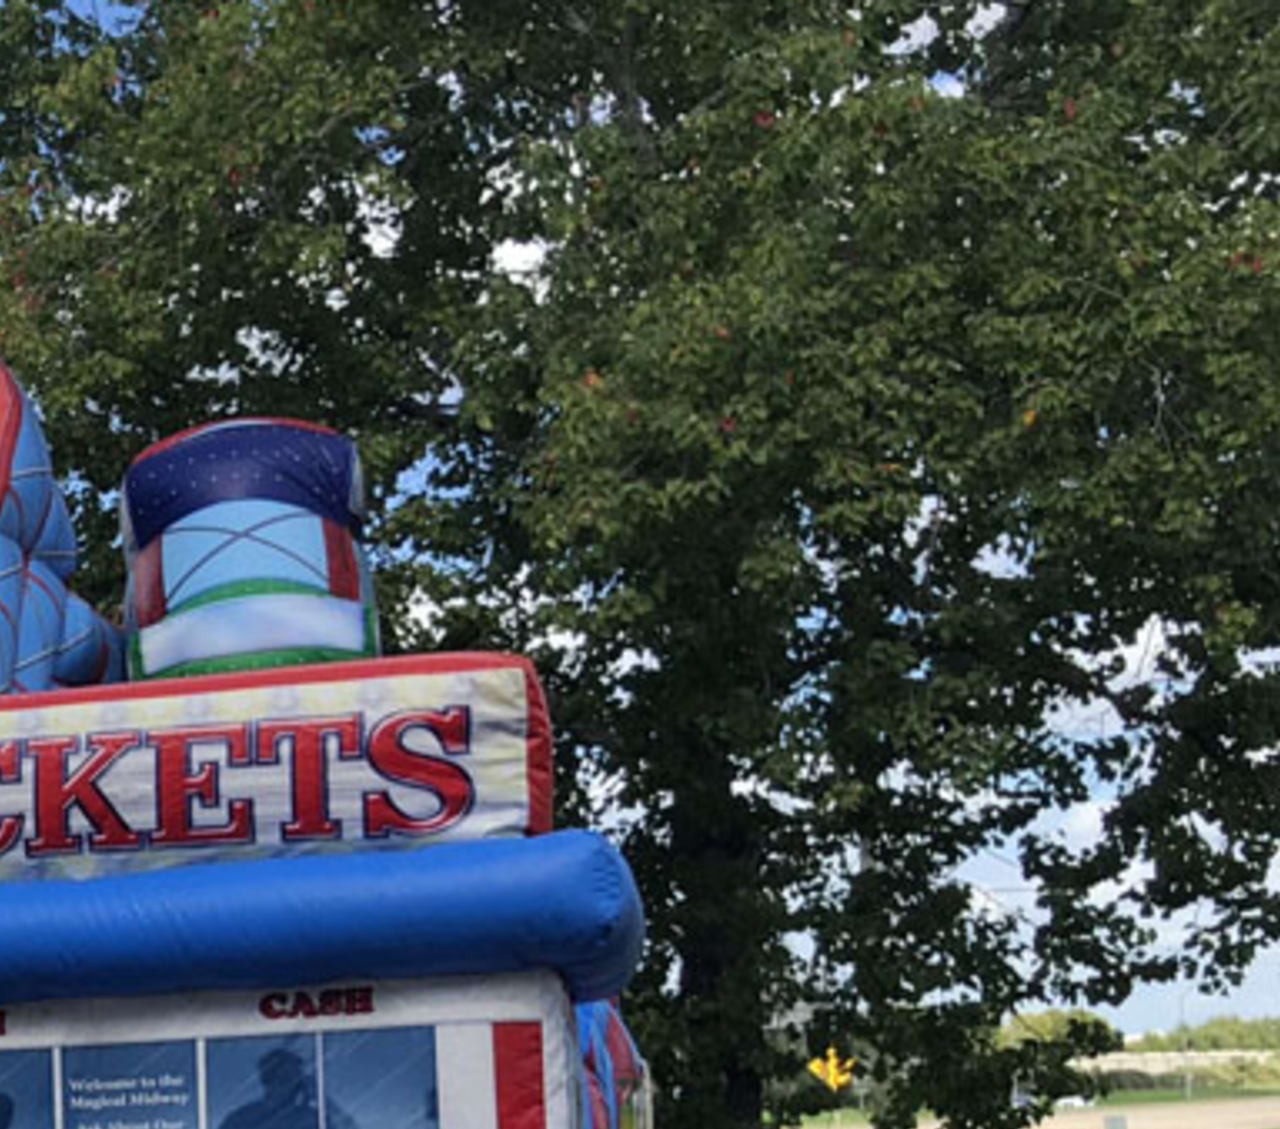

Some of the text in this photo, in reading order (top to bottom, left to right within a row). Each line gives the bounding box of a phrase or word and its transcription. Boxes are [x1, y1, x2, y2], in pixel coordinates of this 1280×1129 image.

[258, 987, 375, 1019] CASH
[70, 1078, 137, 1092] Welcome
[70, 1091, 189, 1110] Magical Midway
